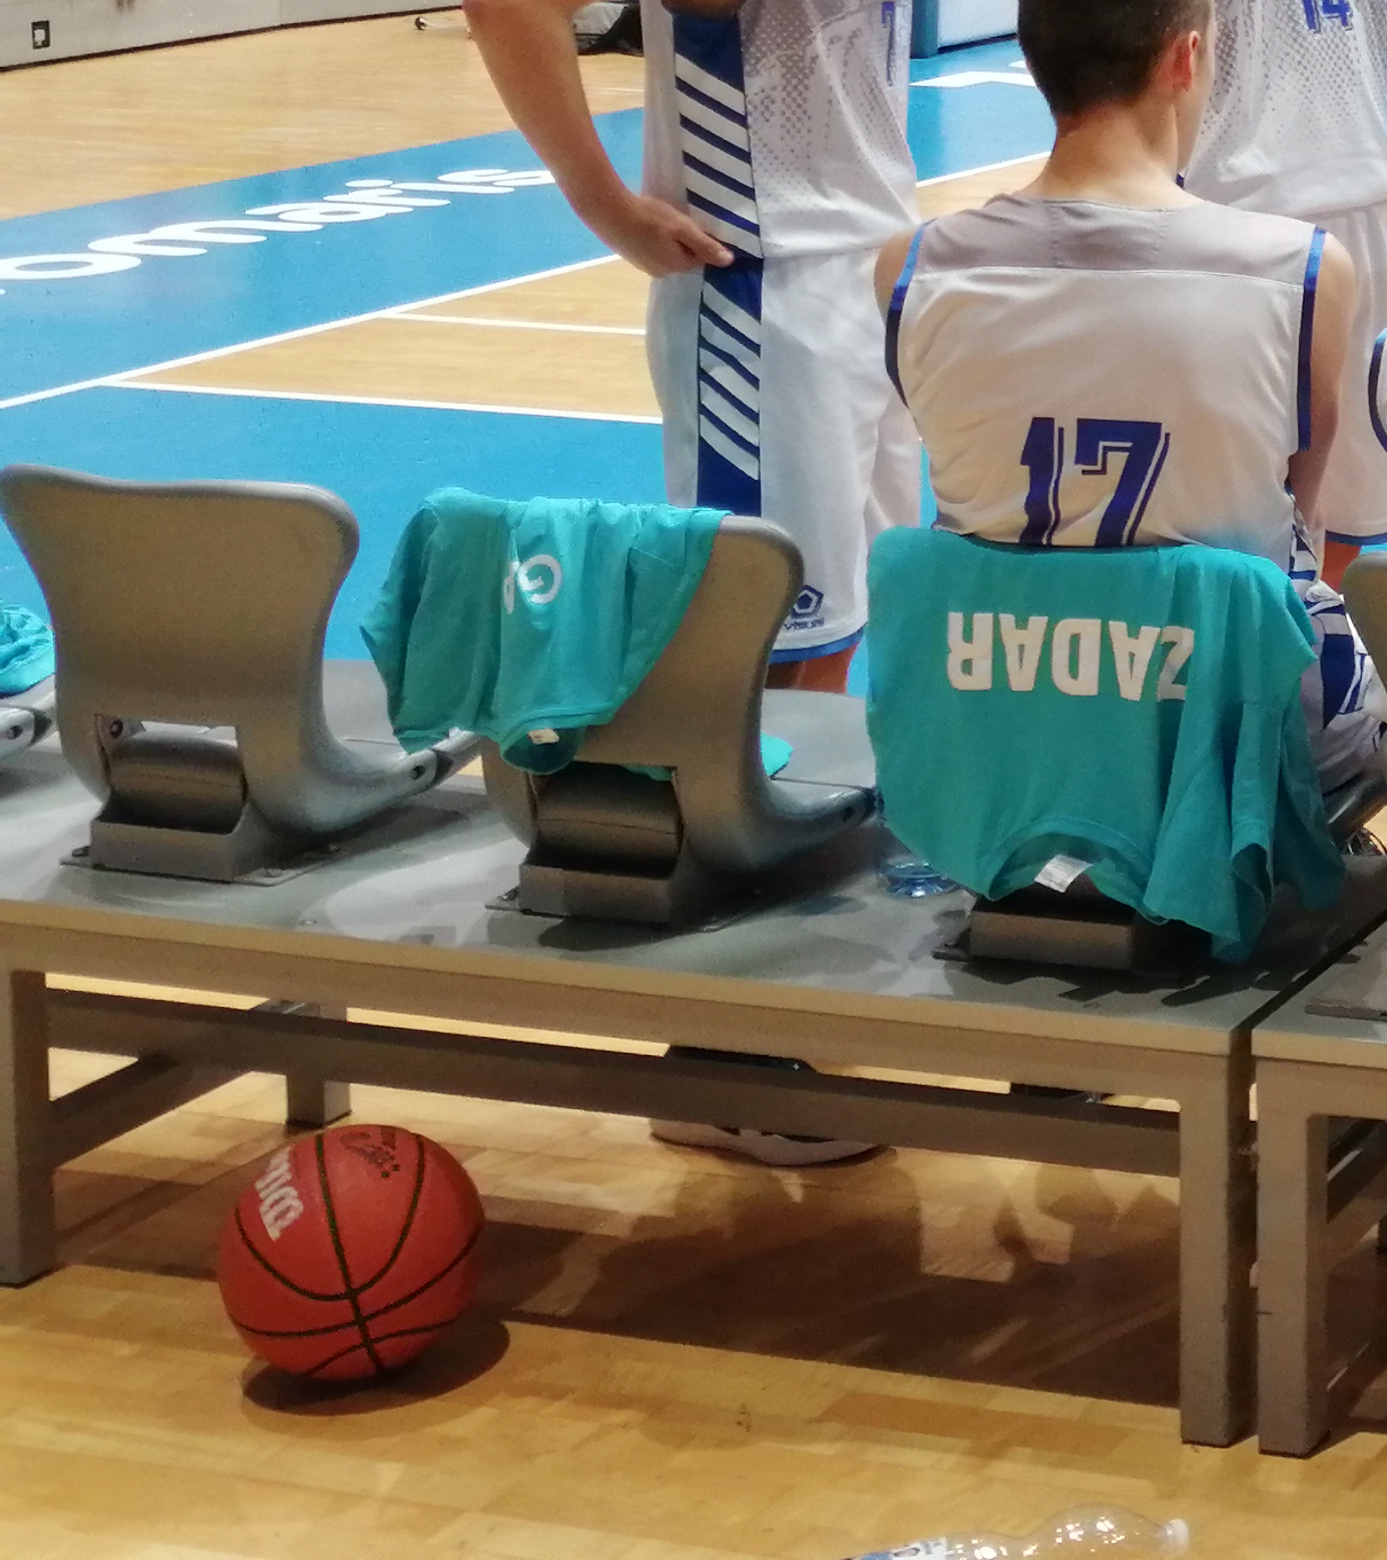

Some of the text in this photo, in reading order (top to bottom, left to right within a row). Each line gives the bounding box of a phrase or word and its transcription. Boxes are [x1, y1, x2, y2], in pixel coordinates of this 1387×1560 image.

[0, 168, 558, 281] omaris
[1020, 416, 1172, 546] 17
[946, 611, 1196, 703] ZADAR
